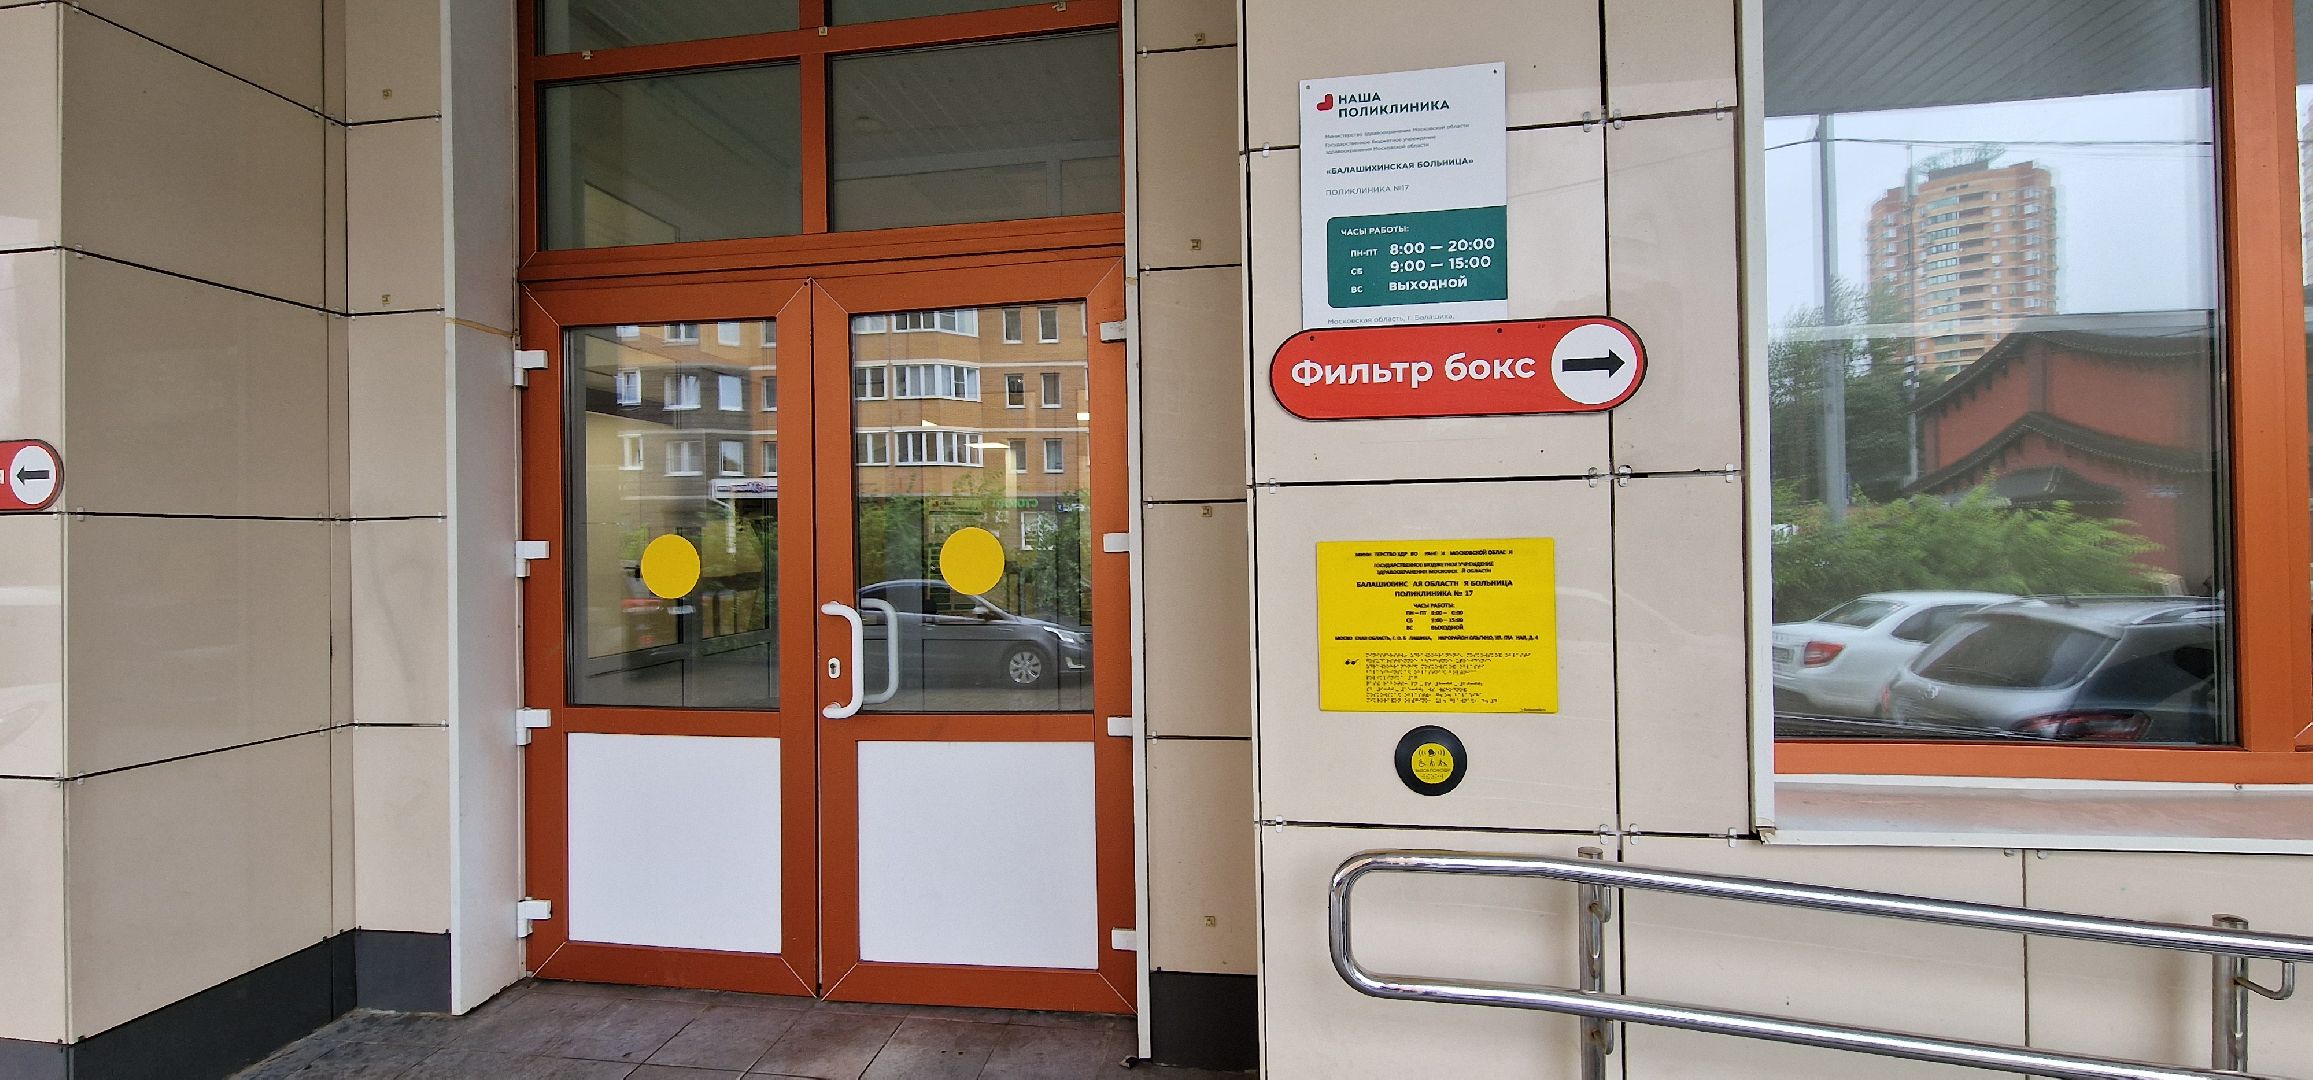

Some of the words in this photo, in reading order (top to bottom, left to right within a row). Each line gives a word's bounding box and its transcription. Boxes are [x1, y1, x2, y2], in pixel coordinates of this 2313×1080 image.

[1338, 92, 1381, 104] НАША
[1338, 100, 1450, 118] ПОЛИКЛИНИКА
[1326, 162, 1415, 175] «БАЛАШИХИНСКАЯ
[1416, 157, 1474, 169] БОЛЬНИЦА»
[1325, 185, 1392, 196] ПОЛИКЛИНИКА
[1340, 227, 1368, 237] ЧАСЫ
[1369, 225, 1410, 235] РАБОТЫ:
[1350, 247, 1378, 257] ПН-ПТ
[1389, 241, 1426, 256] 8:00
[1447, 237, 1495, 252] 20:00
[1350, 266, 1363, 276] СБ
[1389, 259, 1426, 273] 9:00
[1448, 255, 1491, 269] 15:00
[1350, 285, 1363, 294] ВС
[1291, 359, 1434, 389] Фильтр
[1444, 352, 1536, 382] бокс
[1470, 579, 1513, 587] БОЛЬНИЦА
